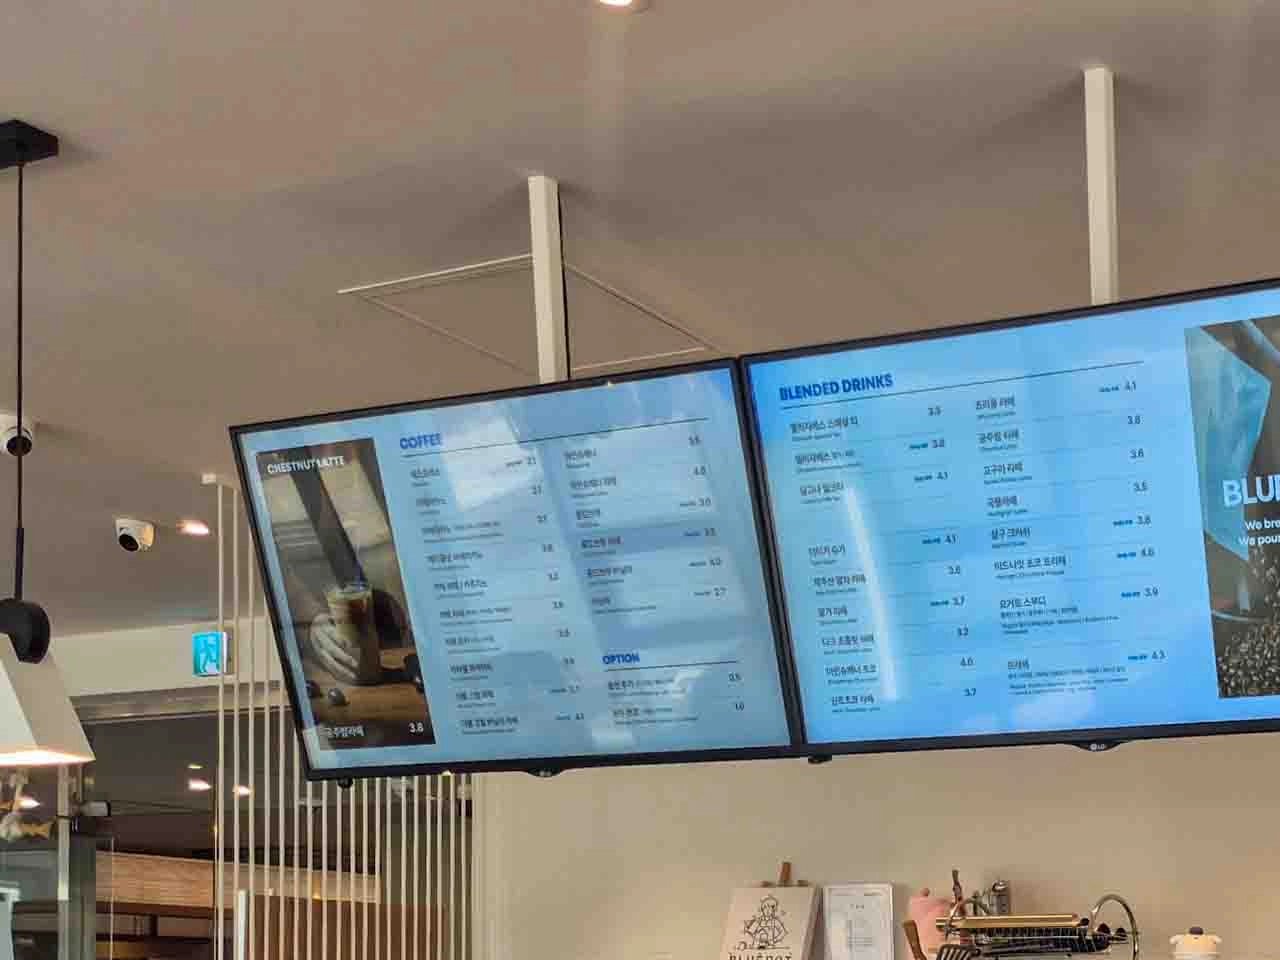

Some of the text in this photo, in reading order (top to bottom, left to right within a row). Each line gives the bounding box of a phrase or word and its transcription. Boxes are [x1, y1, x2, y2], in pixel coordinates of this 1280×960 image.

[779, 373, 894, 401] BLENDED DRINKS
[400, 433, 441, 450] COFFEE
[1245, 519, 1262, 531] We
[602, 652, 641, 666] OPTION
